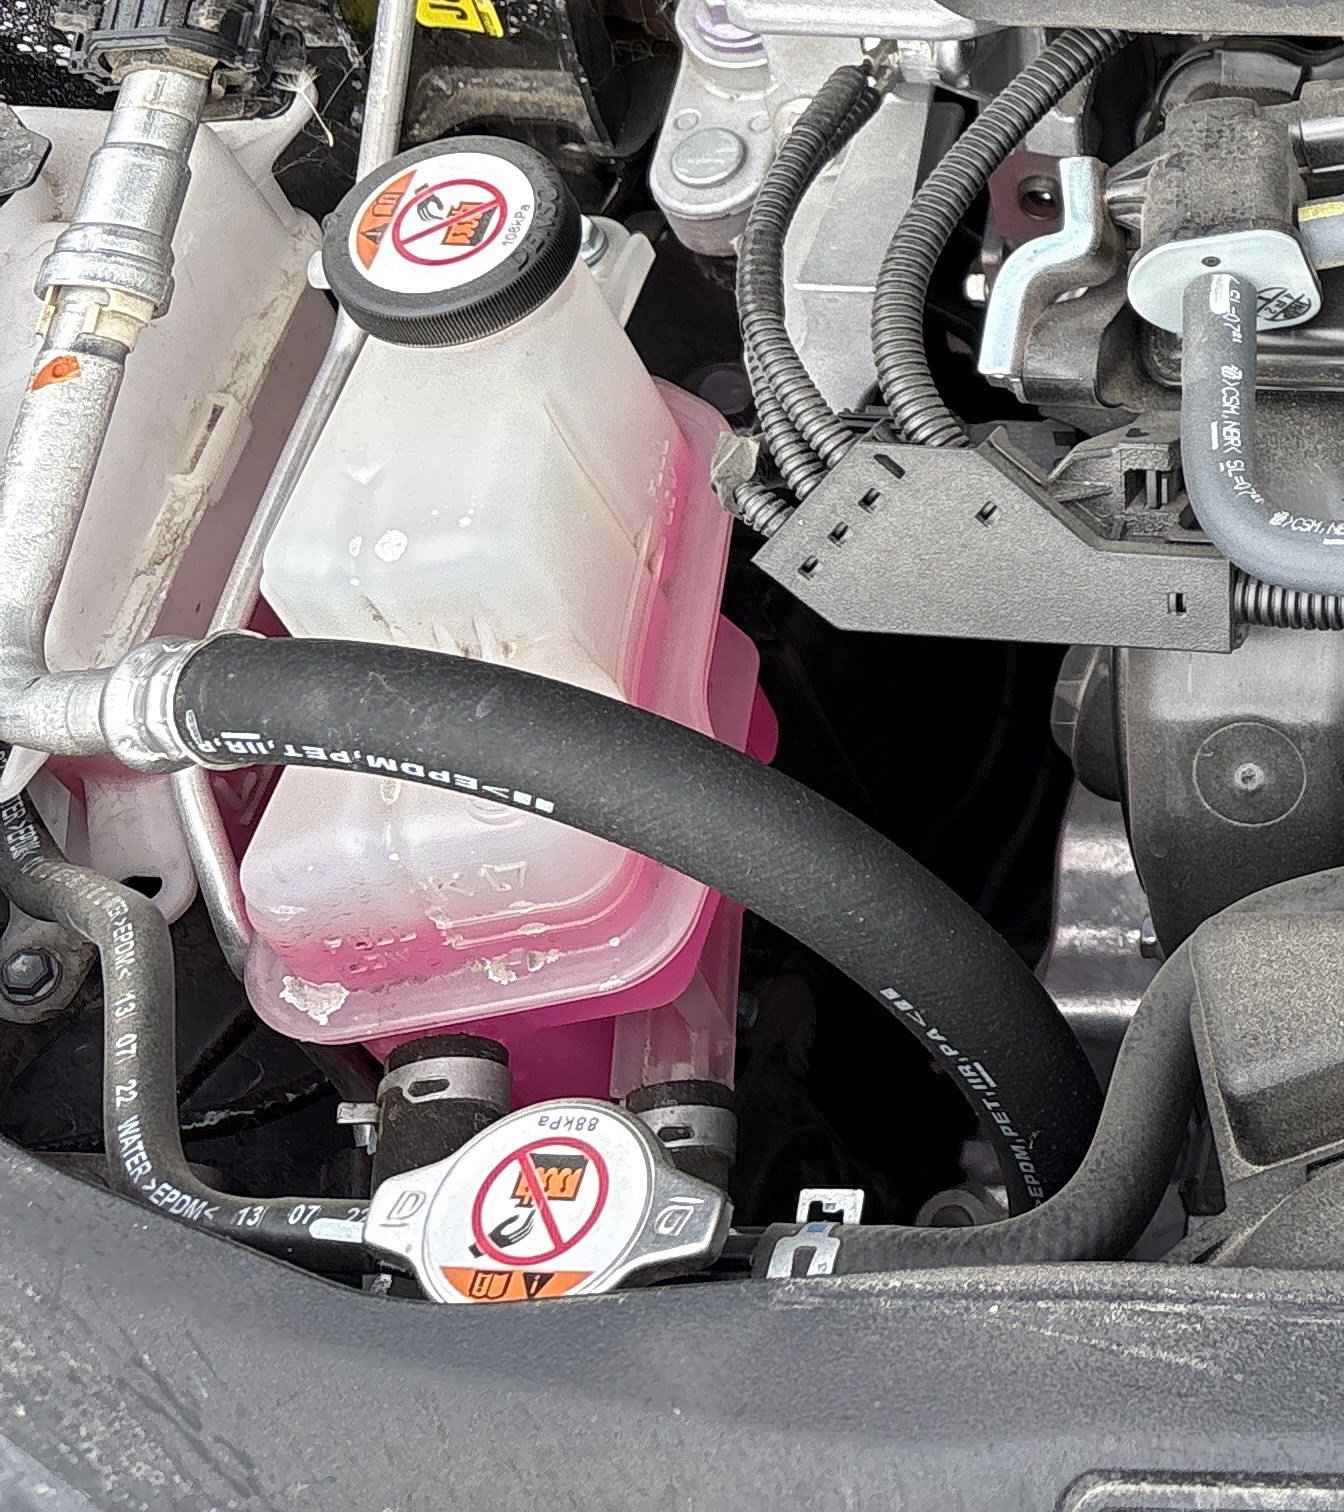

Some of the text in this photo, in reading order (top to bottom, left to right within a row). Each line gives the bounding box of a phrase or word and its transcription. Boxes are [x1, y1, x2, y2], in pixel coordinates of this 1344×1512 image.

[501, 204, 531, 246] 108kPa
[115, 1079, 139, 1110] 22
[538, 1114, 600, 1132] 88kPa
[117, 1113, 153, 1185] WATER
